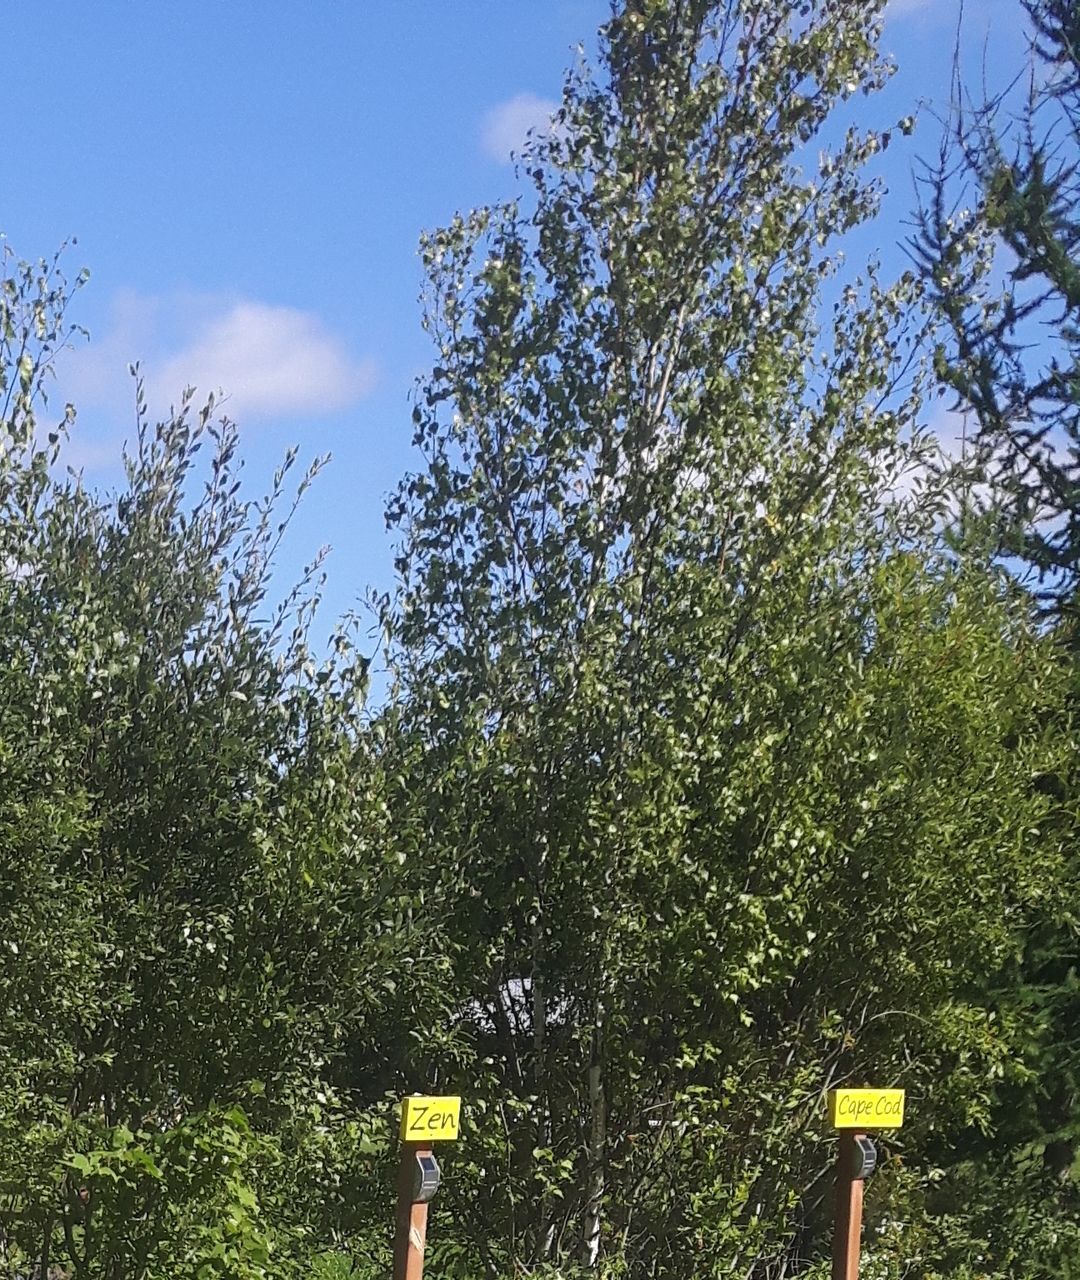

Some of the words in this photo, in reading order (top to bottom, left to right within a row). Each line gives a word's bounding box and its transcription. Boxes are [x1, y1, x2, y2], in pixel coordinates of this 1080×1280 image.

[410, 1106, 456, 1131] Zen
[839, 1095, 873, 1121] Cape
[876, 1094, 902, 1115] Cod
